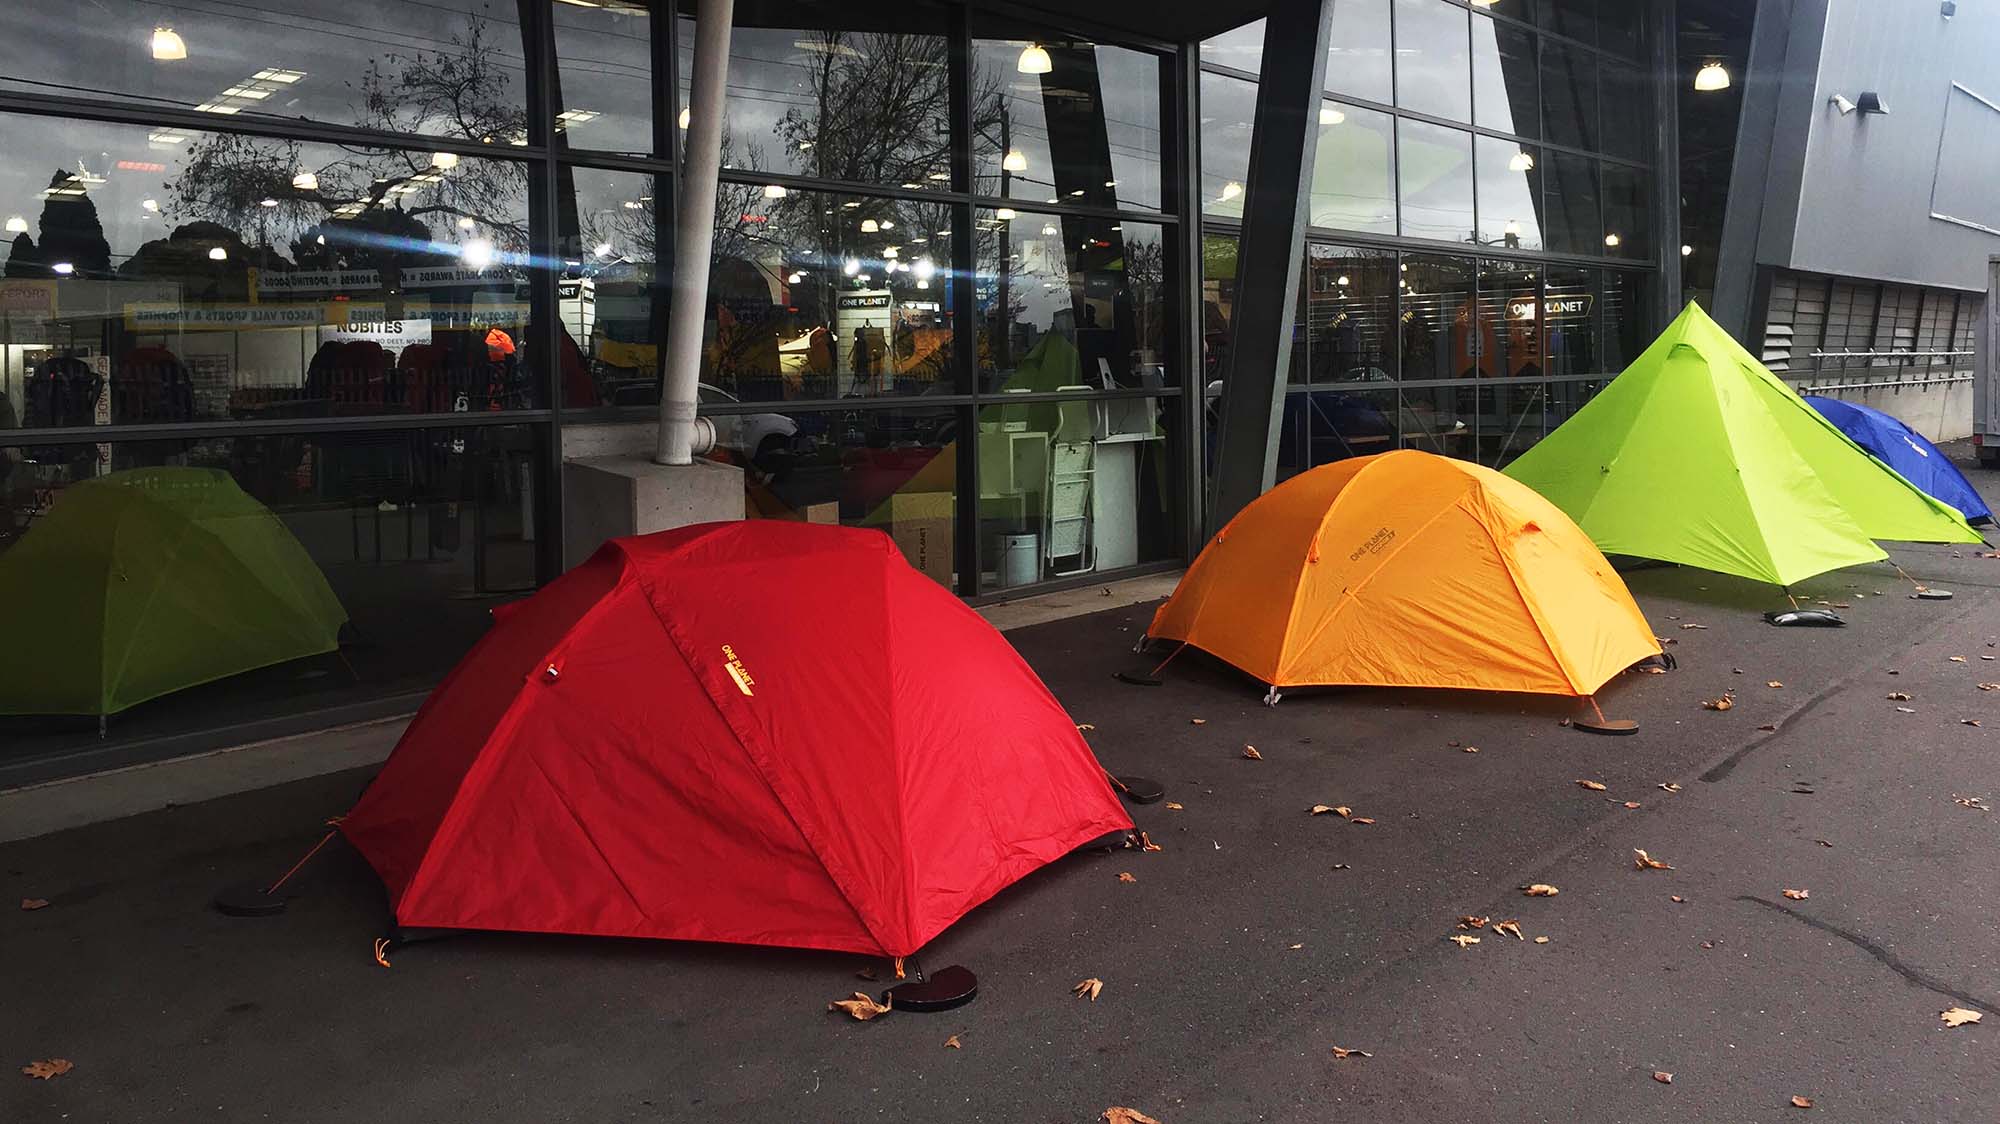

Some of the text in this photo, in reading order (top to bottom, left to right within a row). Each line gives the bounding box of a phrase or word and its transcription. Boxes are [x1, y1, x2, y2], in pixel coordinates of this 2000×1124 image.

[859, 297, 887, 306] PLANET
[337, 320, 403, 334] NOBITES
[1350, 547, 1367, 562] ONE
[1364, 527, 1389, 550] PLANET
[722, 644, 738, 661] ONE
[732, 659, 756, 686] PLANET
